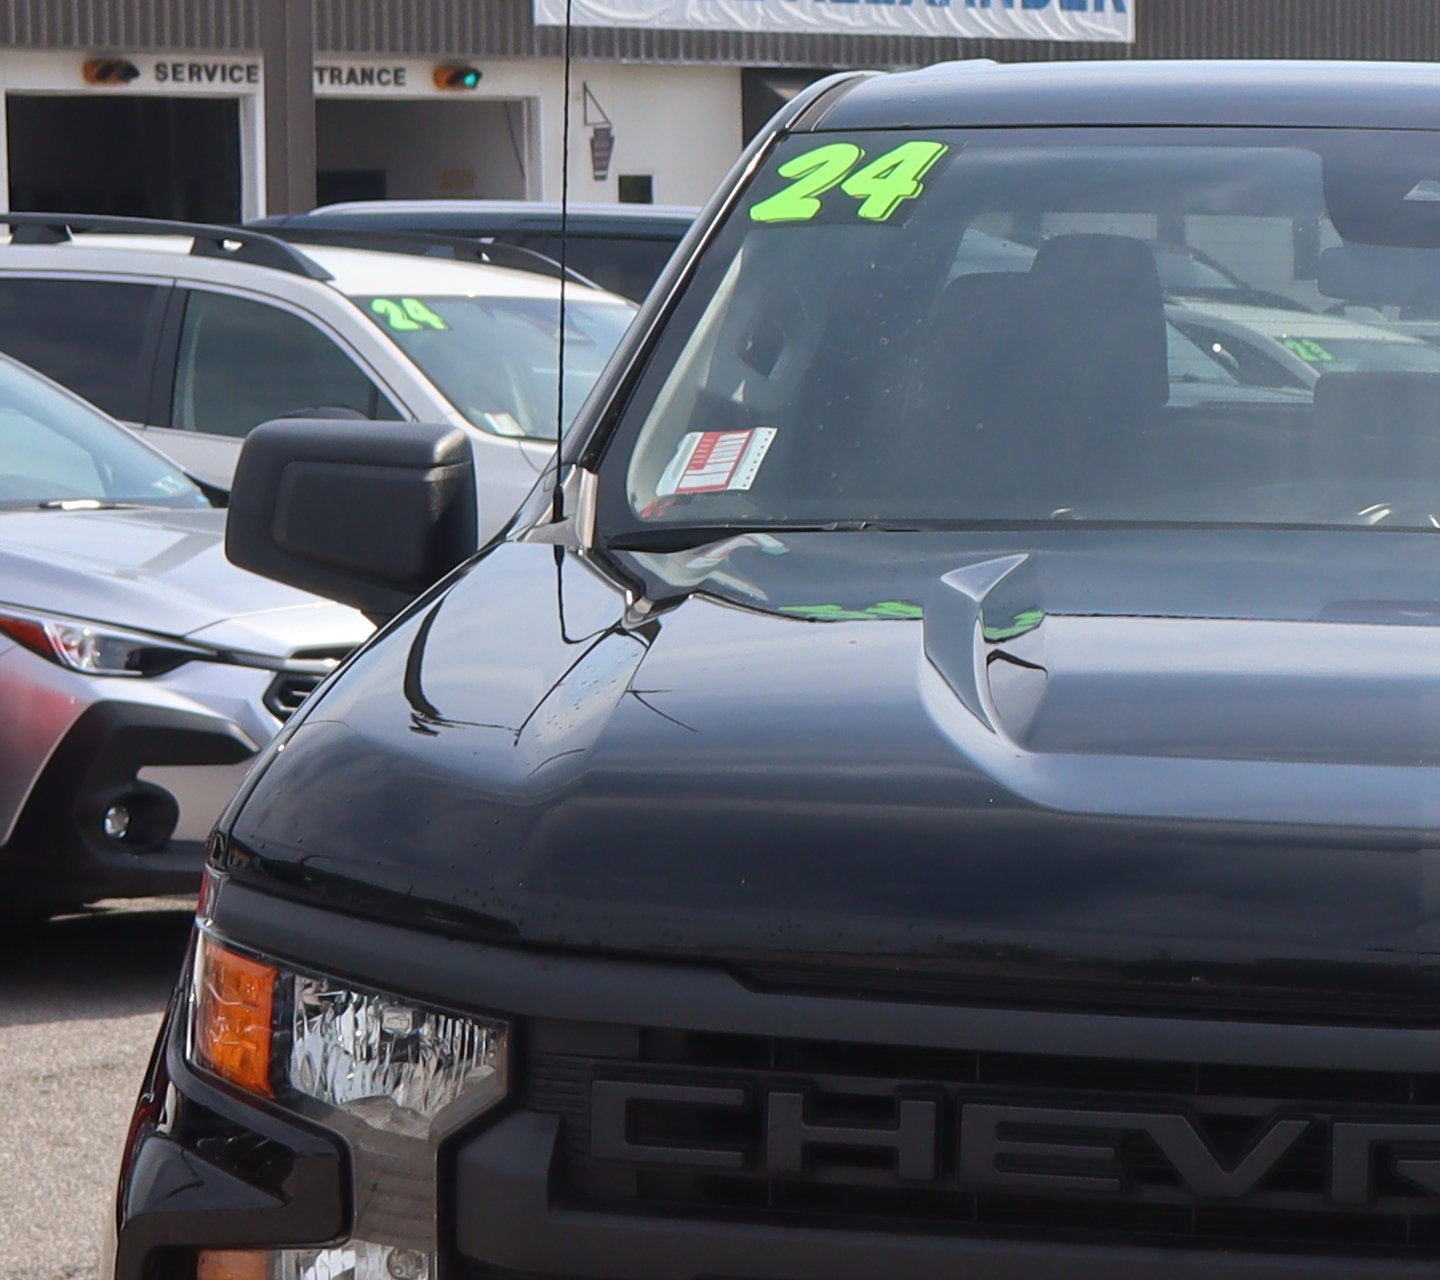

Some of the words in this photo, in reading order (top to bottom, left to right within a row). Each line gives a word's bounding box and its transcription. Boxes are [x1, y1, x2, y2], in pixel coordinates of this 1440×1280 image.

[155, 63, 259, 83] SERVICE
[749, 140, 949, 223] 24
[371, 297, 448, 330] 24
